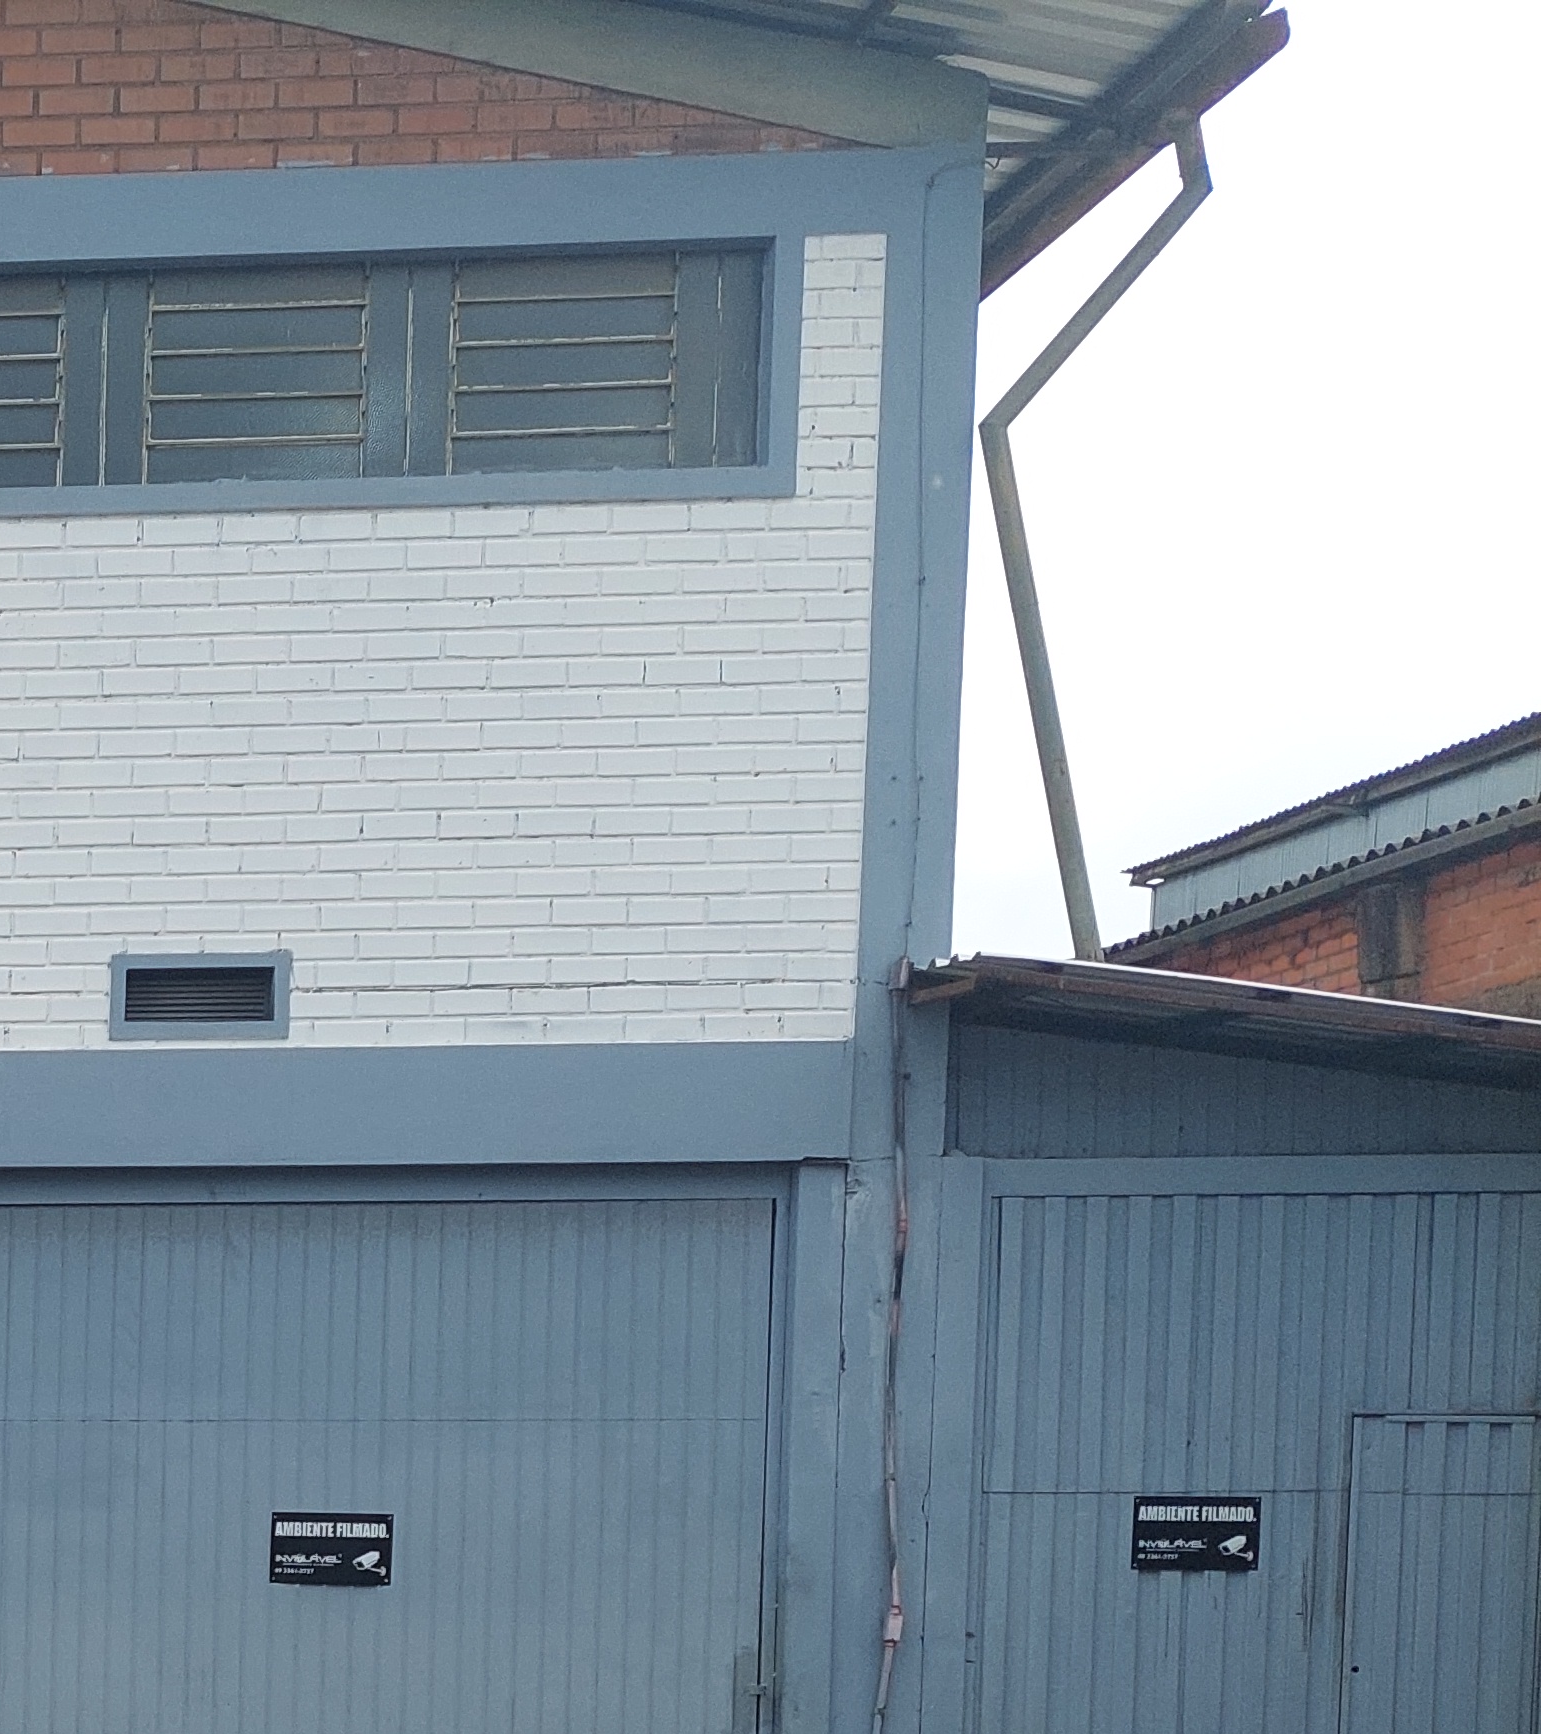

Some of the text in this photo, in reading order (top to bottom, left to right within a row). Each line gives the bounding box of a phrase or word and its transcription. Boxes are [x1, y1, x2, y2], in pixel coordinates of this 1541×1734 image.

[1138, 1505, 1257, 1522] AMBIENTE FILMADO.
[274, 1521, 390, 1538] AMBIENTE FILMADO.
